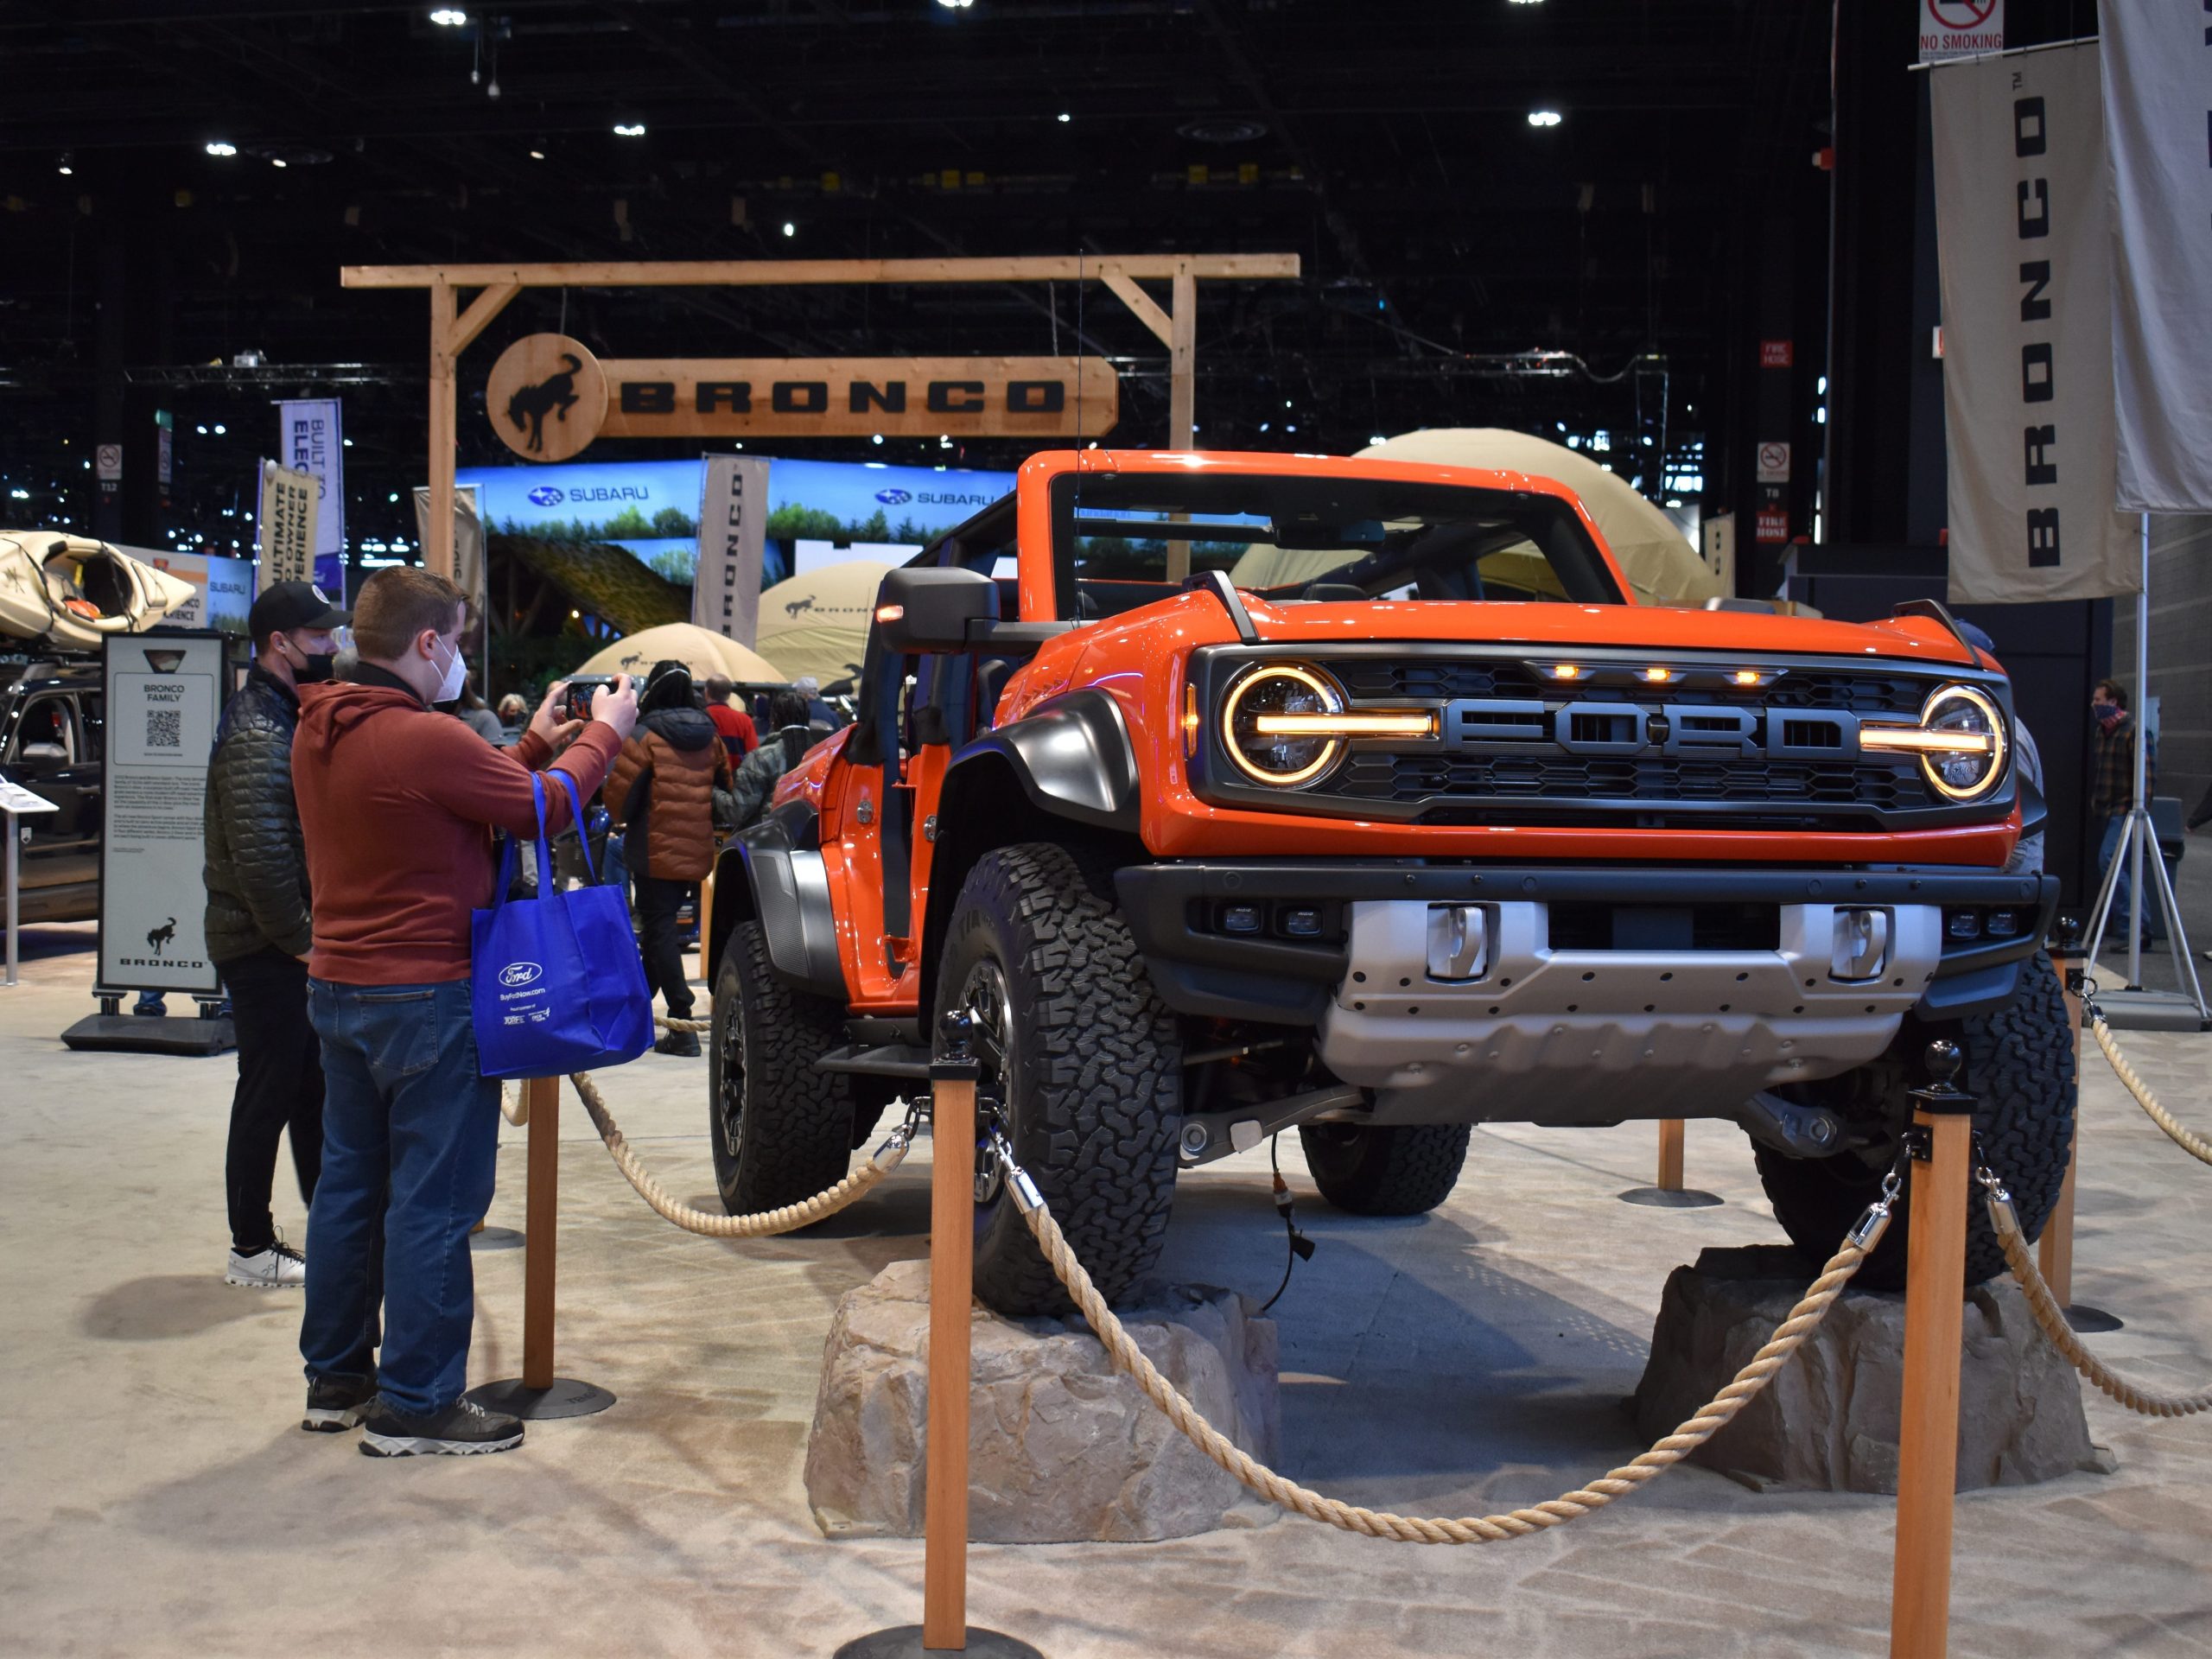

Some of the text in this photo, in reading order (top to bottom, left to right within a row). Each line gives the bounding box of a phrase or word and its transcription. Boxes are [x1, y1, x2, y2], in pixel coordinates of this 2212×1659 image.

[1920, 33, 2002, 50] NO SMOKING
[2013, 94, 2062, 568] BRONCO
[620, 379, 1065, 414] BRONCO
[311, 419, 326, 469] BUILT
[569, 486, 650, 502] SUBARU
[286, 486, 296, 562] OWNER
[209, 582, 246, 594] SUBARU
[143, 683, 185, 693] BRONCO
[147, 694, 181, 703] FAMILY
[1448, 698, 1859, 761] FORD
[119, 957, 204, 969] BRONCO
[505, 966, 532, 983] Ford
